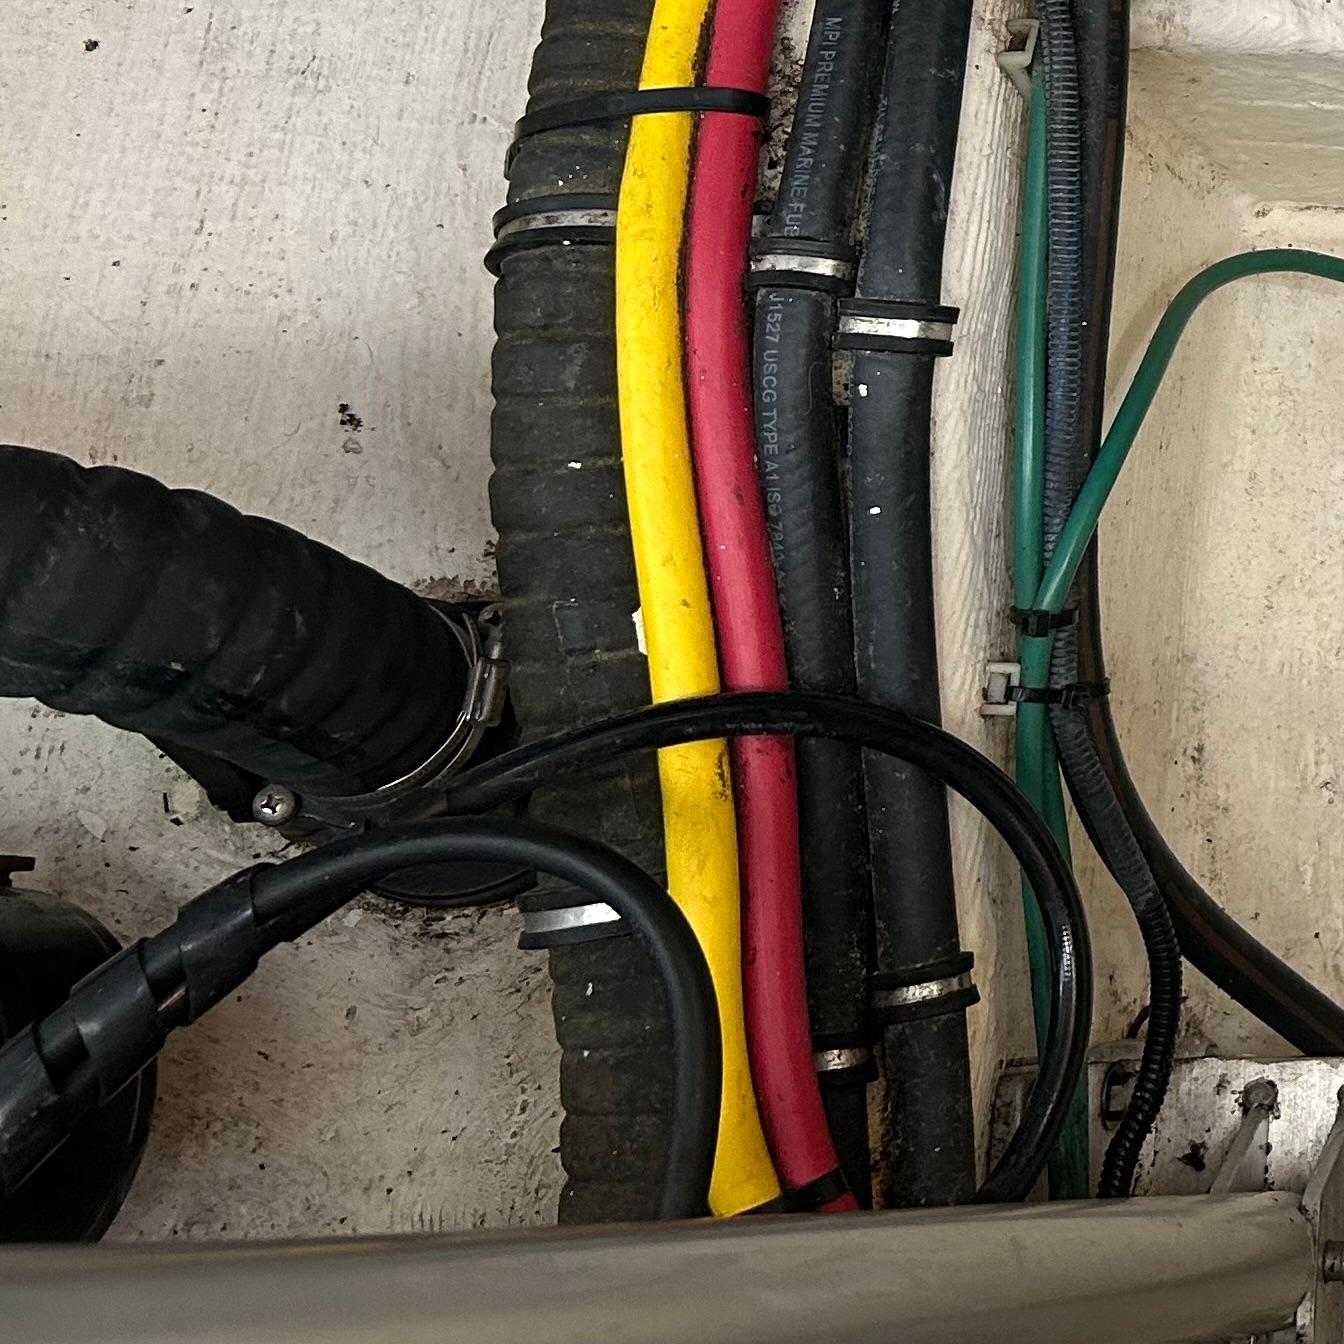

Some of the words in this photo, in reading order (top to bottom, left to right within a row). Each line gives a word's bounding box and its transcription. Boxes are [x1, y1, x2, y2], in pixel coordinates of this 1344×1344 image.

[820, 14, 843, 46] MPI
[803, 48, 837, 129] PREMIUM
[789, 130, 820, 201] MARINE
[782, 200, 805, 238] FUE
[760, 349, 779, 403] USCG
[761, 407, 778, 456] TYPE
[763, 459, 779, 481] A1
[765, 486, 783, 516] ISO
